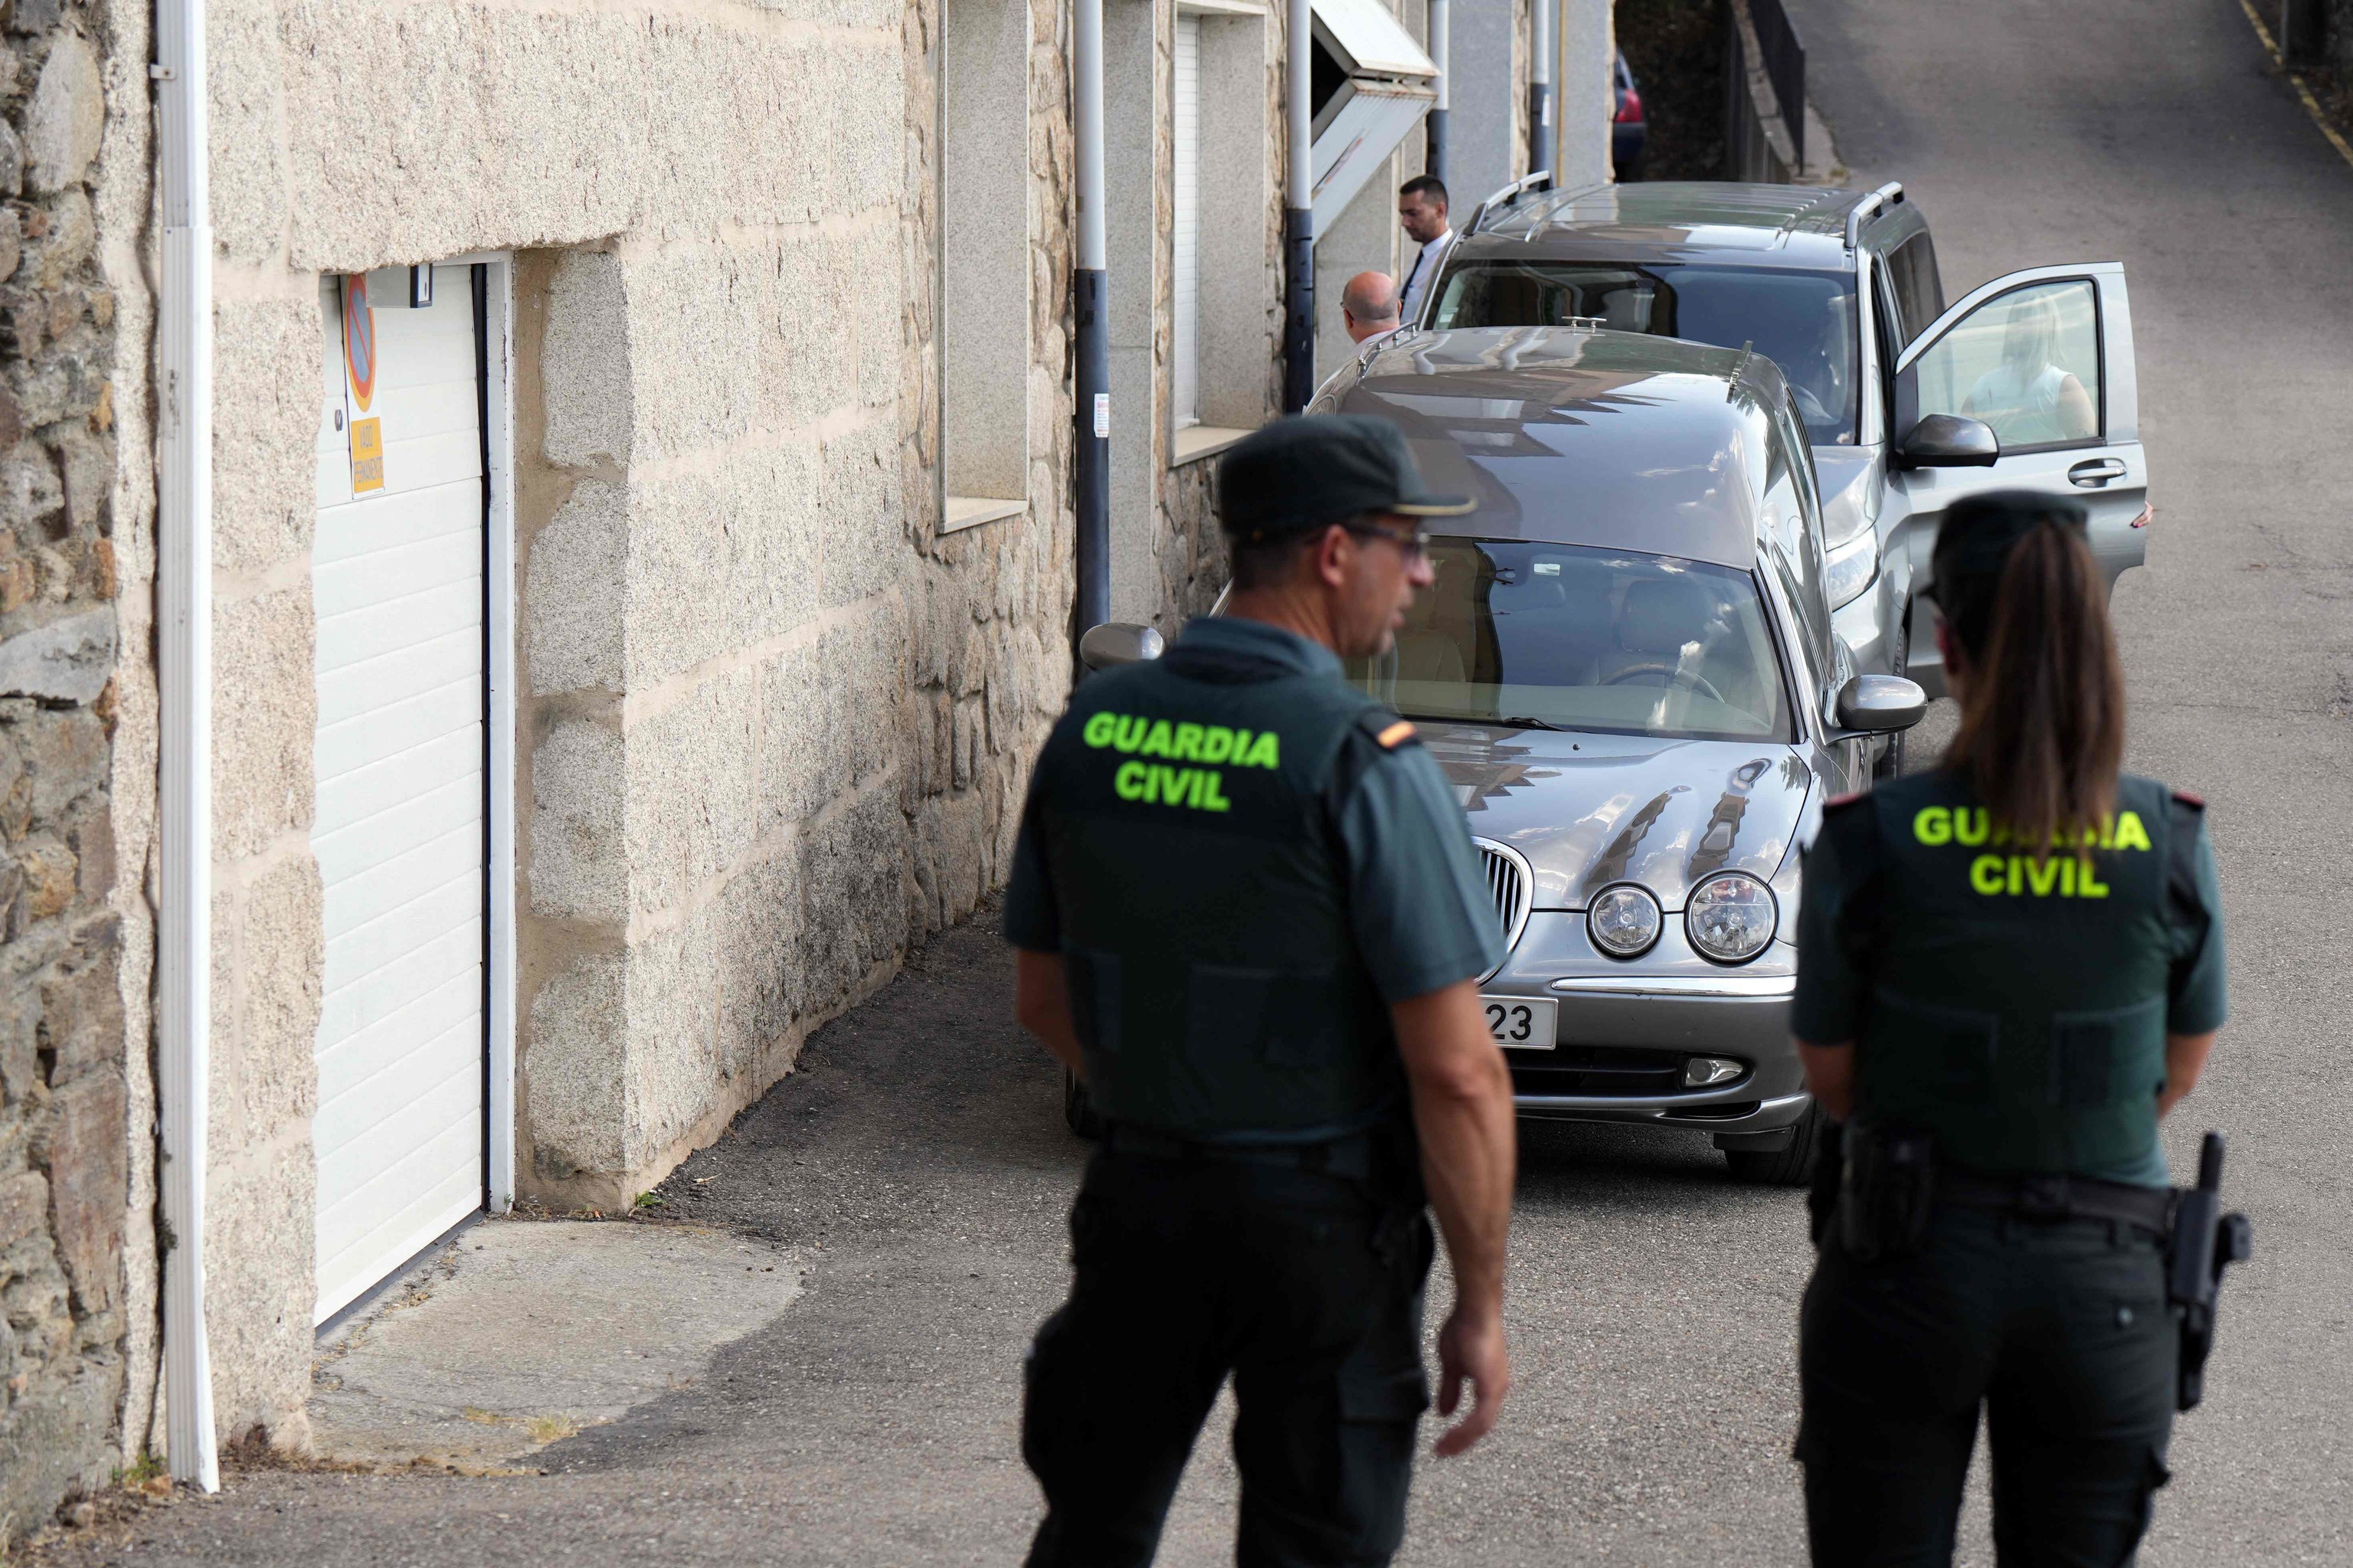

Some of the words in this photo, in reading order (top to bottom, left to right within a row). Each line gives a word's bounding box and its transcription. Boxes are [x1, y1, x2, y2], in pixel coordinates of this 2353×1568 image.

[1083, 711, 1280, 771] GUARDIA
[1114, 760, 1231, 813] CIVIL
[1913, 806, 2152, 851] GUIA
[1969, 854, 2109, 899] CIVIL
[1485, 1003, 1532, 1040] 23
